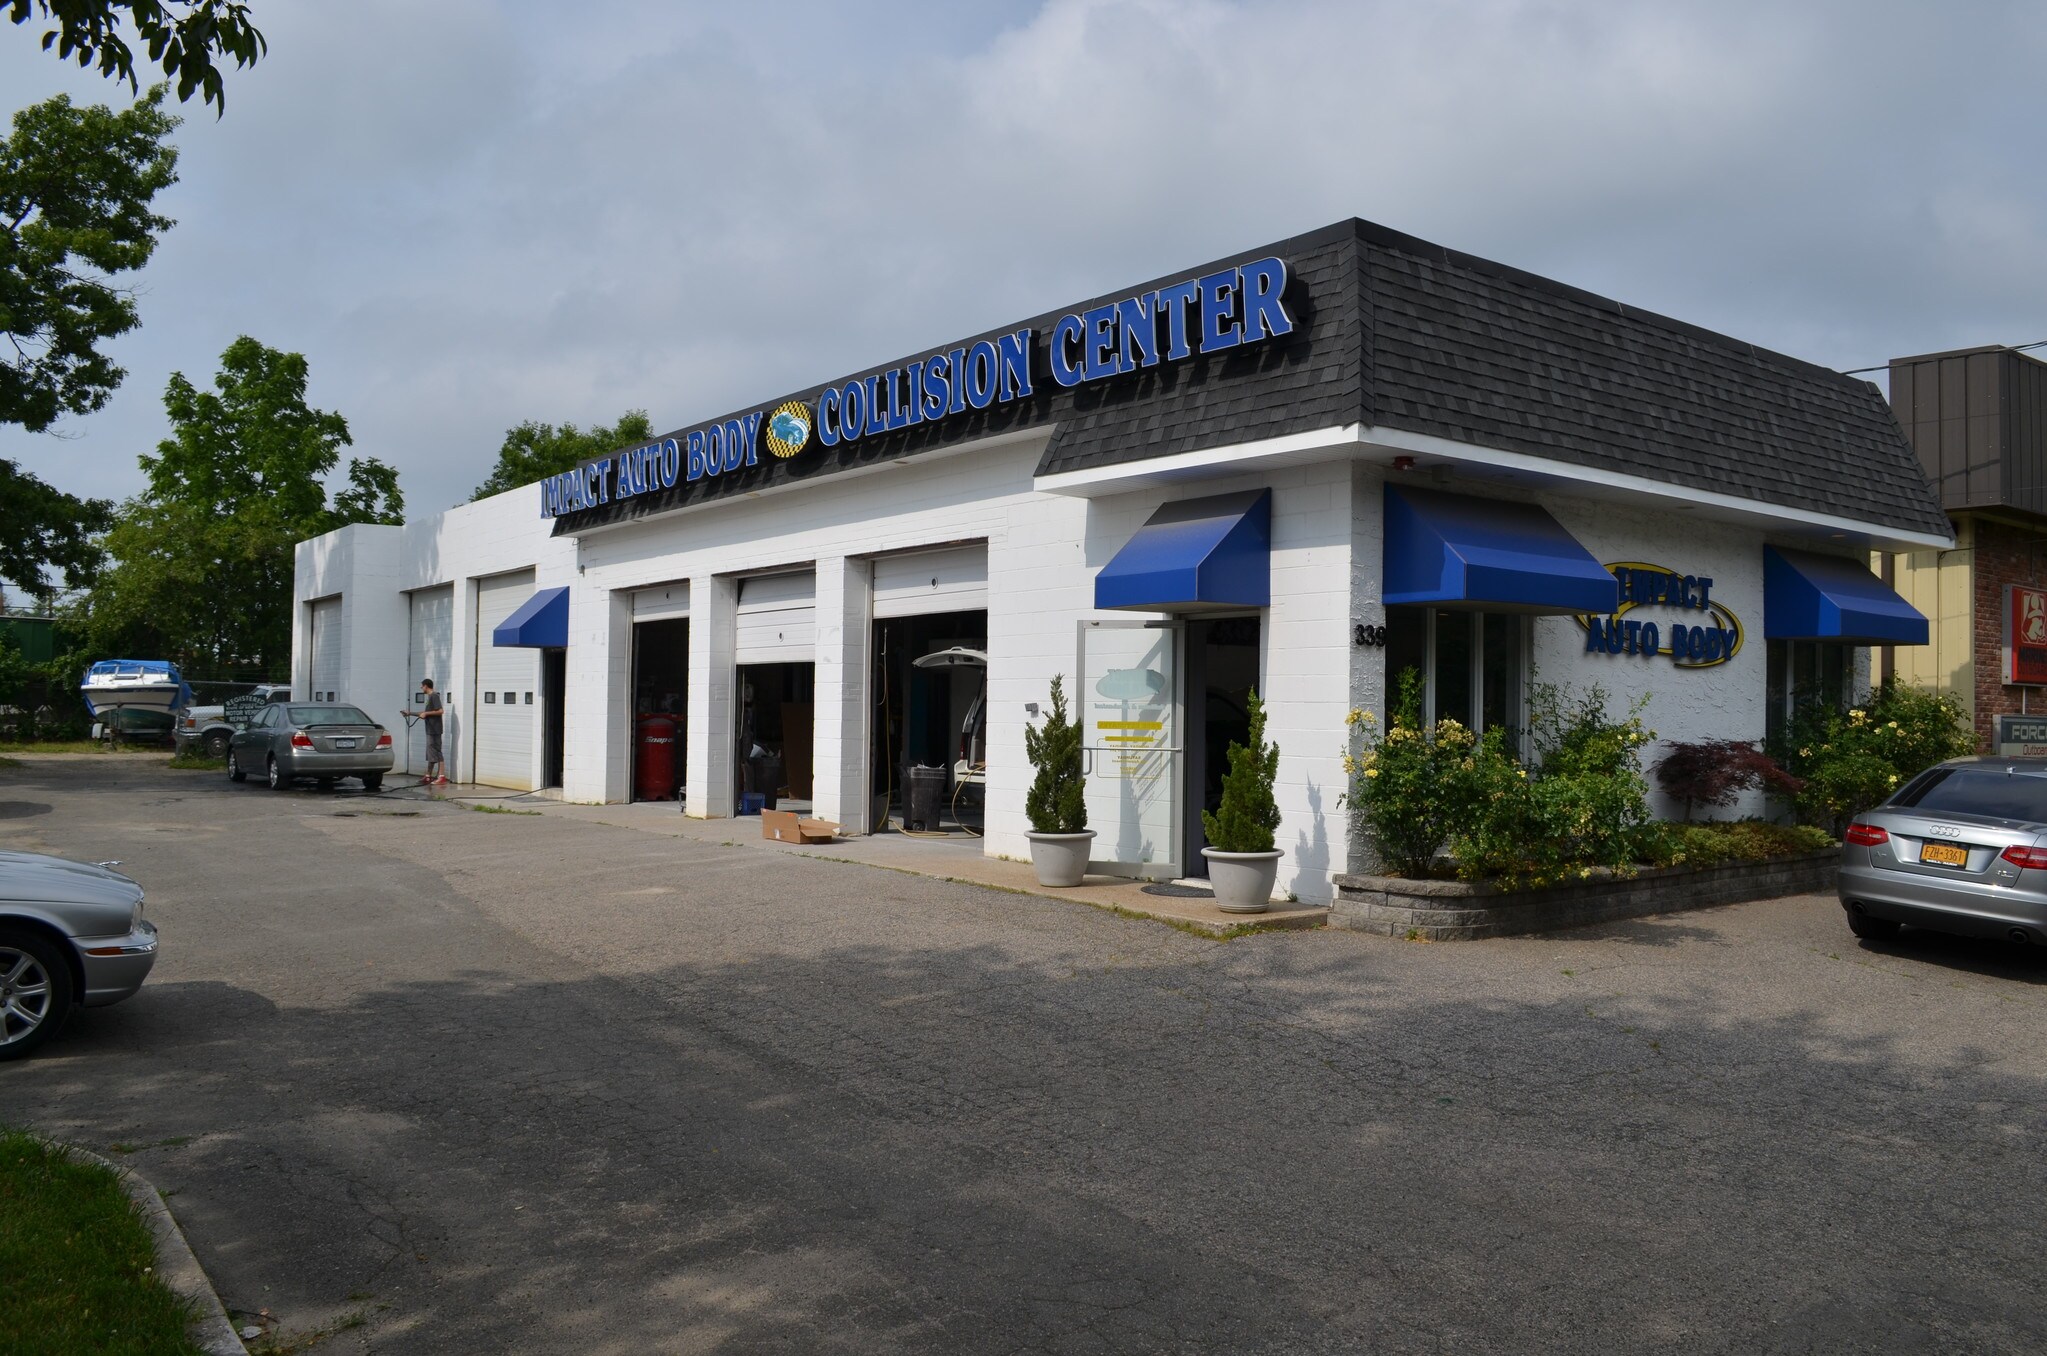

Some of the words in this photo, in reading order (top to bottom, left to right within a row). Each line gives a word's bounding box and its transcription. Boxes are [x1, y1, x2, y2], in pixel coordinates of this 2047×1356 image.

[817, 328, 1034, 447] COLLISION
[1050, 256, 1293, 387] CENTER
[540, 458, 611, 519] IMPACT
[616, 438, 679, 499] AUTO
[687, 411, 763, 481] BODY
[1615, 566, 1713, 610] IMPACT
[1354, 624, 1386, 647] 339
[1586, 617, 1659, 657] AUTO
[1672, 623, 1736, 661] BODY
[225, 696, 265, 706] REGISTERED
[2011, 724, 2047, 740] FORC
